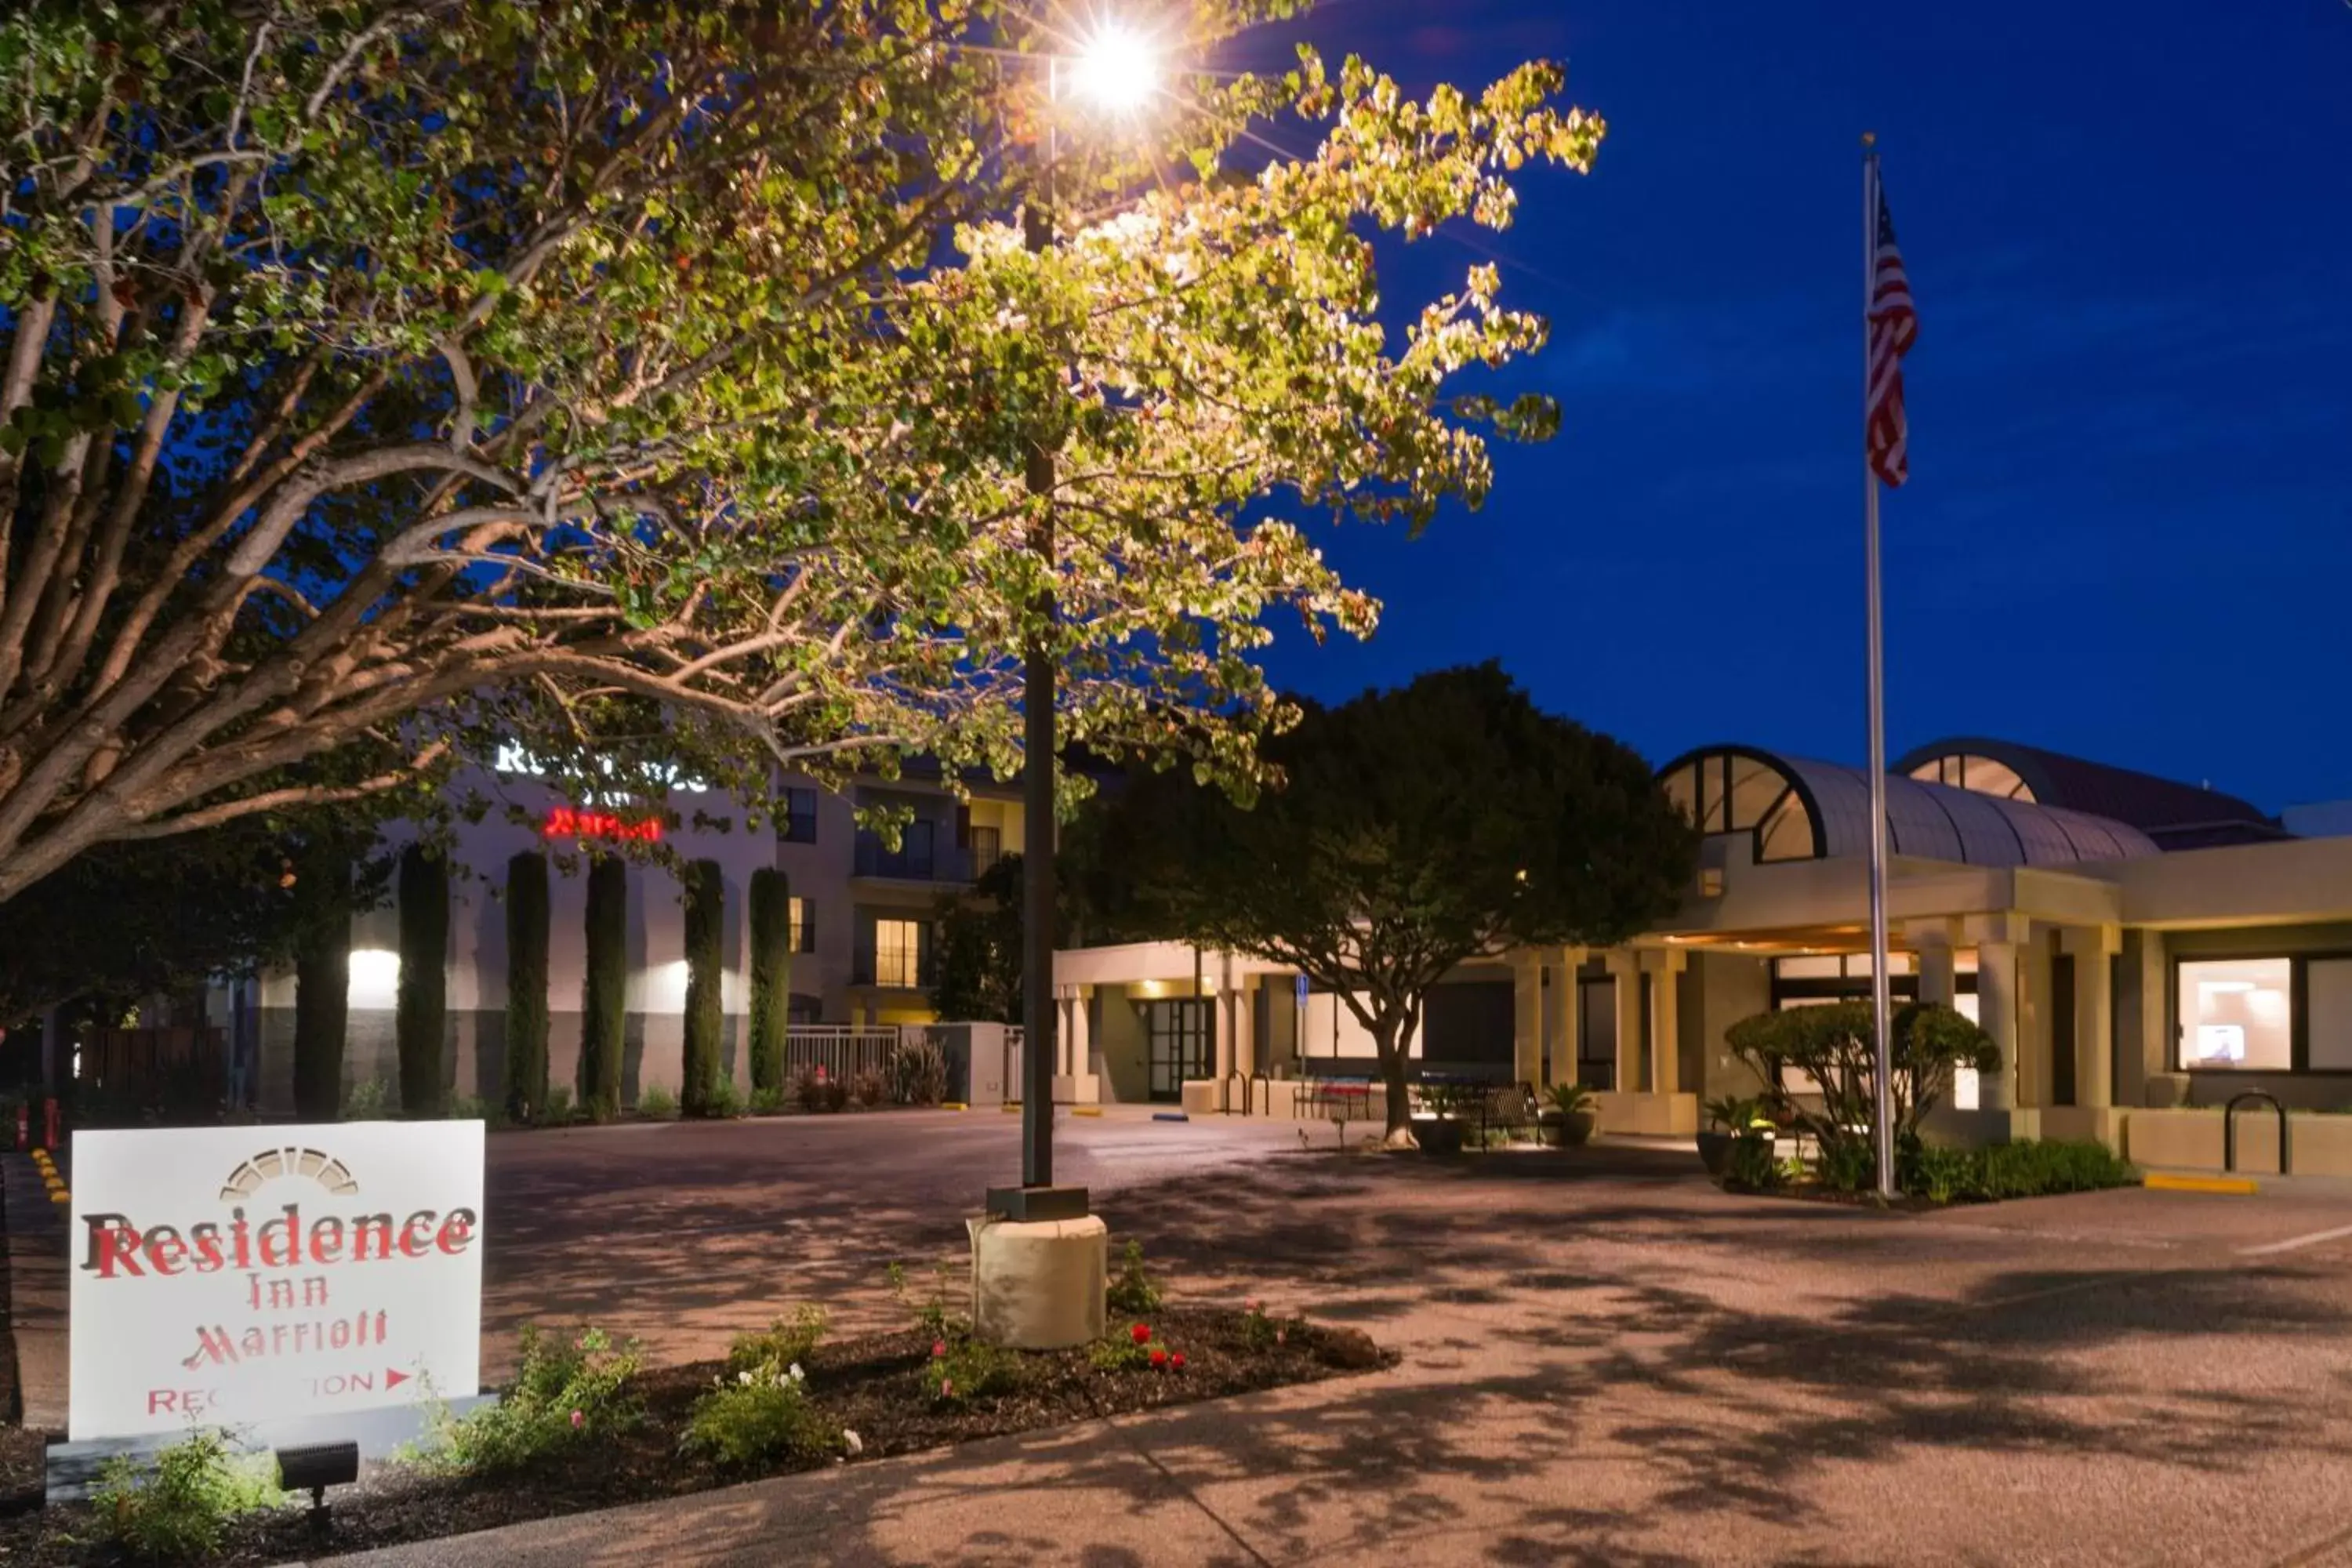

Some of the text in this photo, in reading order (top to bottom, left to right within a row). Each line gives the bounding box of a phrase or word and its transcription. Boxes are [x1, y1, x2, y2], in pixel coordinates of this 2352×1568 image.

[79, 1203, 477, 1279] Residence
[246, 1272, 328, 1311] Inn
[181, 1308, 387, 1371] Marriott
[148, 1370, 373, 1416] RECION
